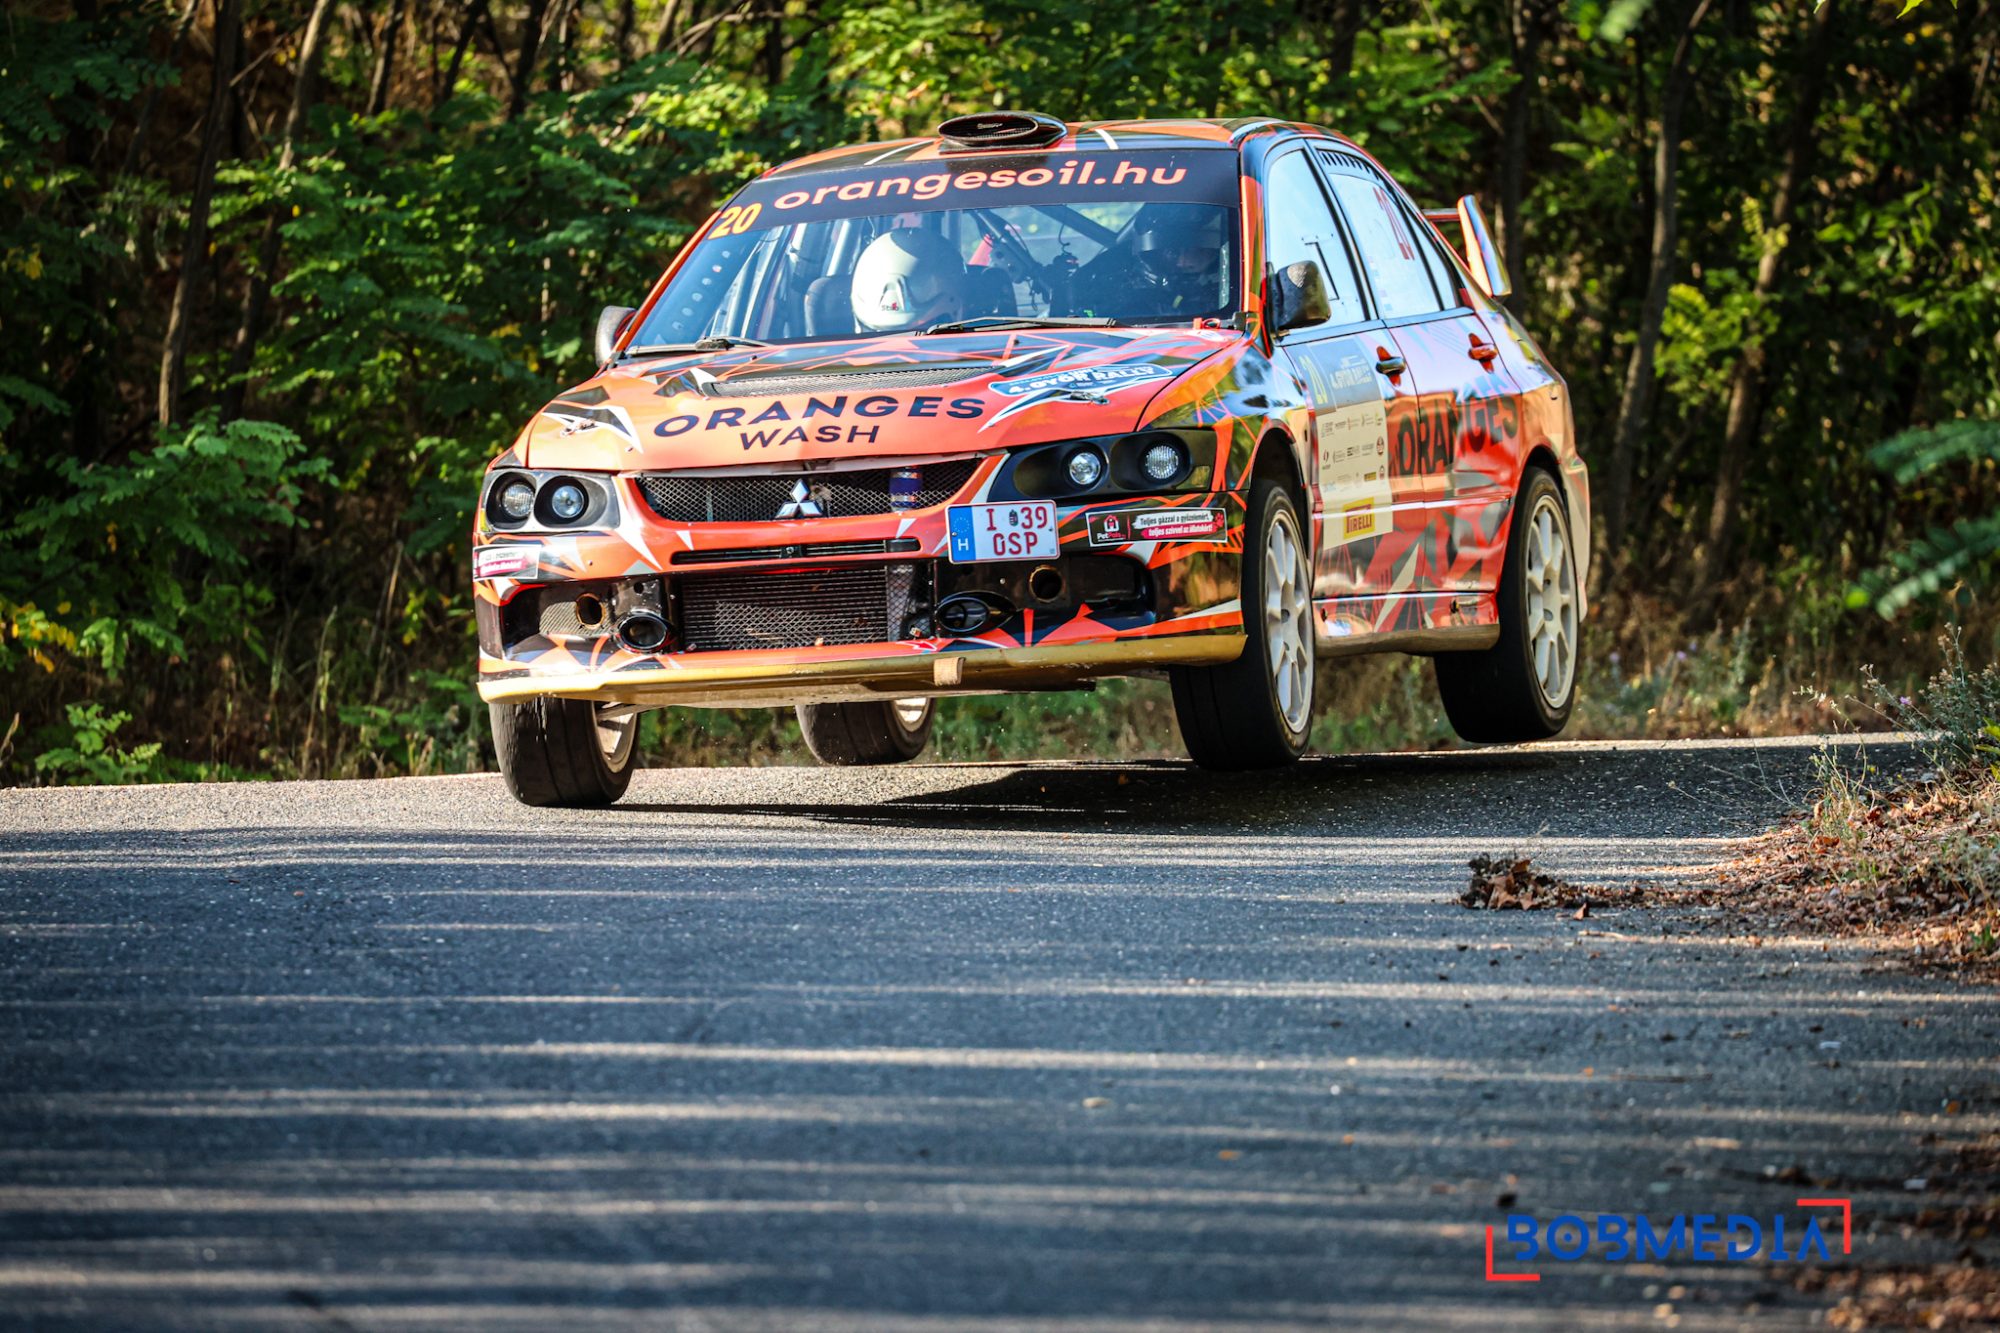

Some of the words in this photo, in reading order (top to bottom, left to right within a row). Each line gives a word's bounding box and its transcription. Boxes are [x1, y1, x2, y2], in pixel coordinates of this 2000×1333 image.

[708, 202, 763, 240] 20
[774, 159, 1187, 209] orangesoil.hu
[1095, 366, 1155, 380] RALLY
[653, 395, 986, 438] ORANGES
[1398, 372, 1519, 475] ORANGES
[740, 425, 880, 450] WASH
[1020, 506, 1048, 529] 39
[1345, 504, 1372, 533] PIRELLI
[957, 538, 969, 551] H
